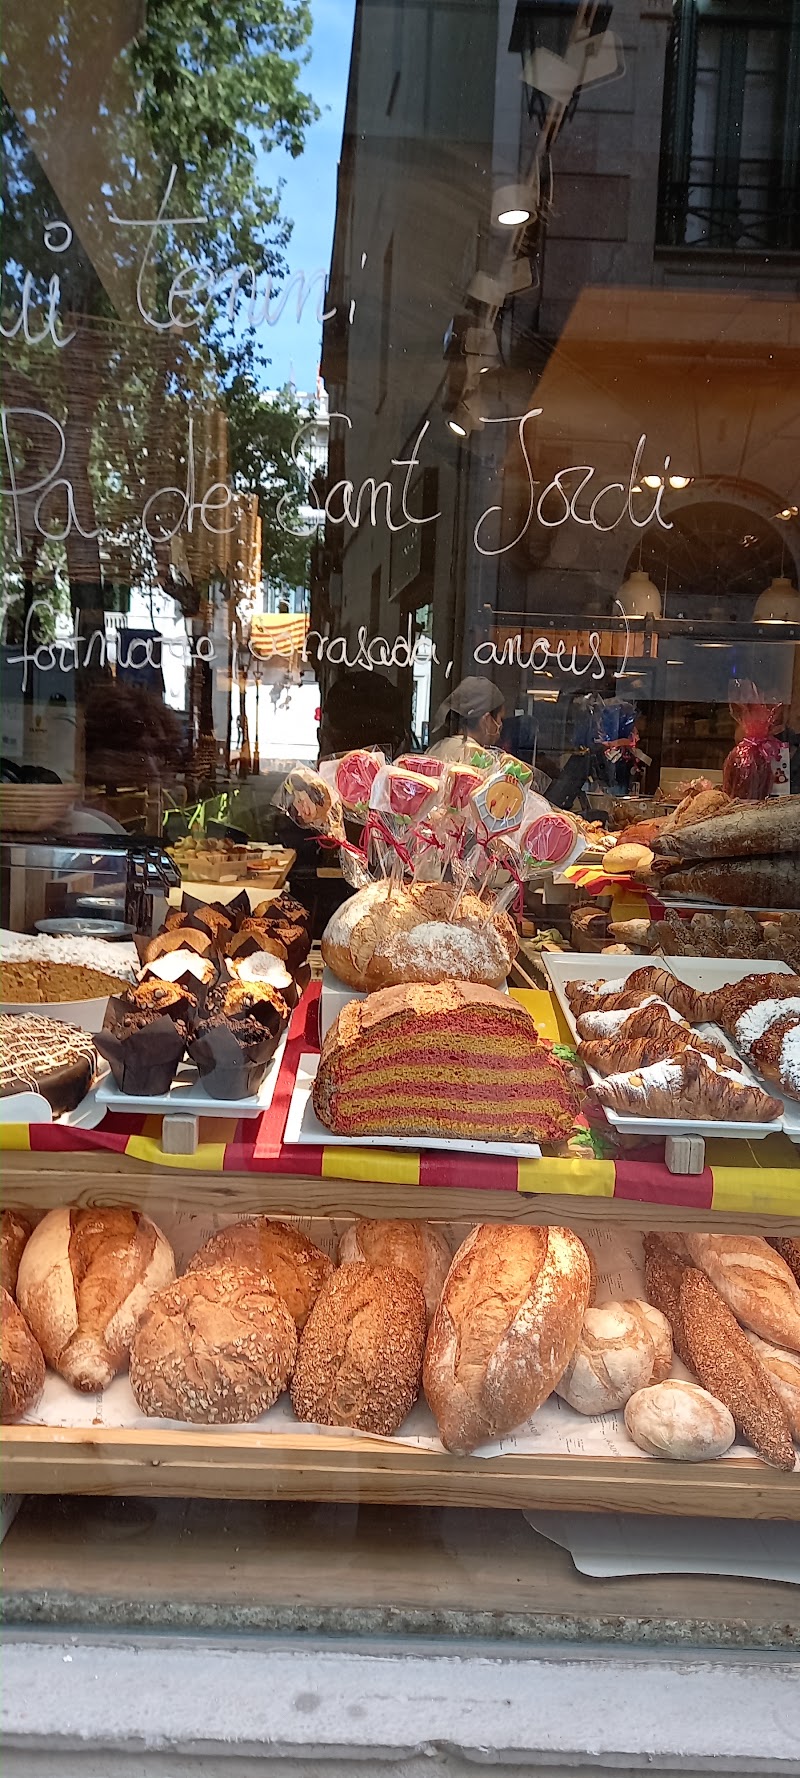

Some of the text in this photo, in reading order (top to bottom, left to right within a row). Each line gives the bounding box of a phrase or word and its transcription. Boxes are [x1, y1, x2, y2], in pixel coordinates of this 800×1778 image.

[0, 407, 674, 557] Pa de Sant Jordi
[473, 600, 631, 679] anous)
